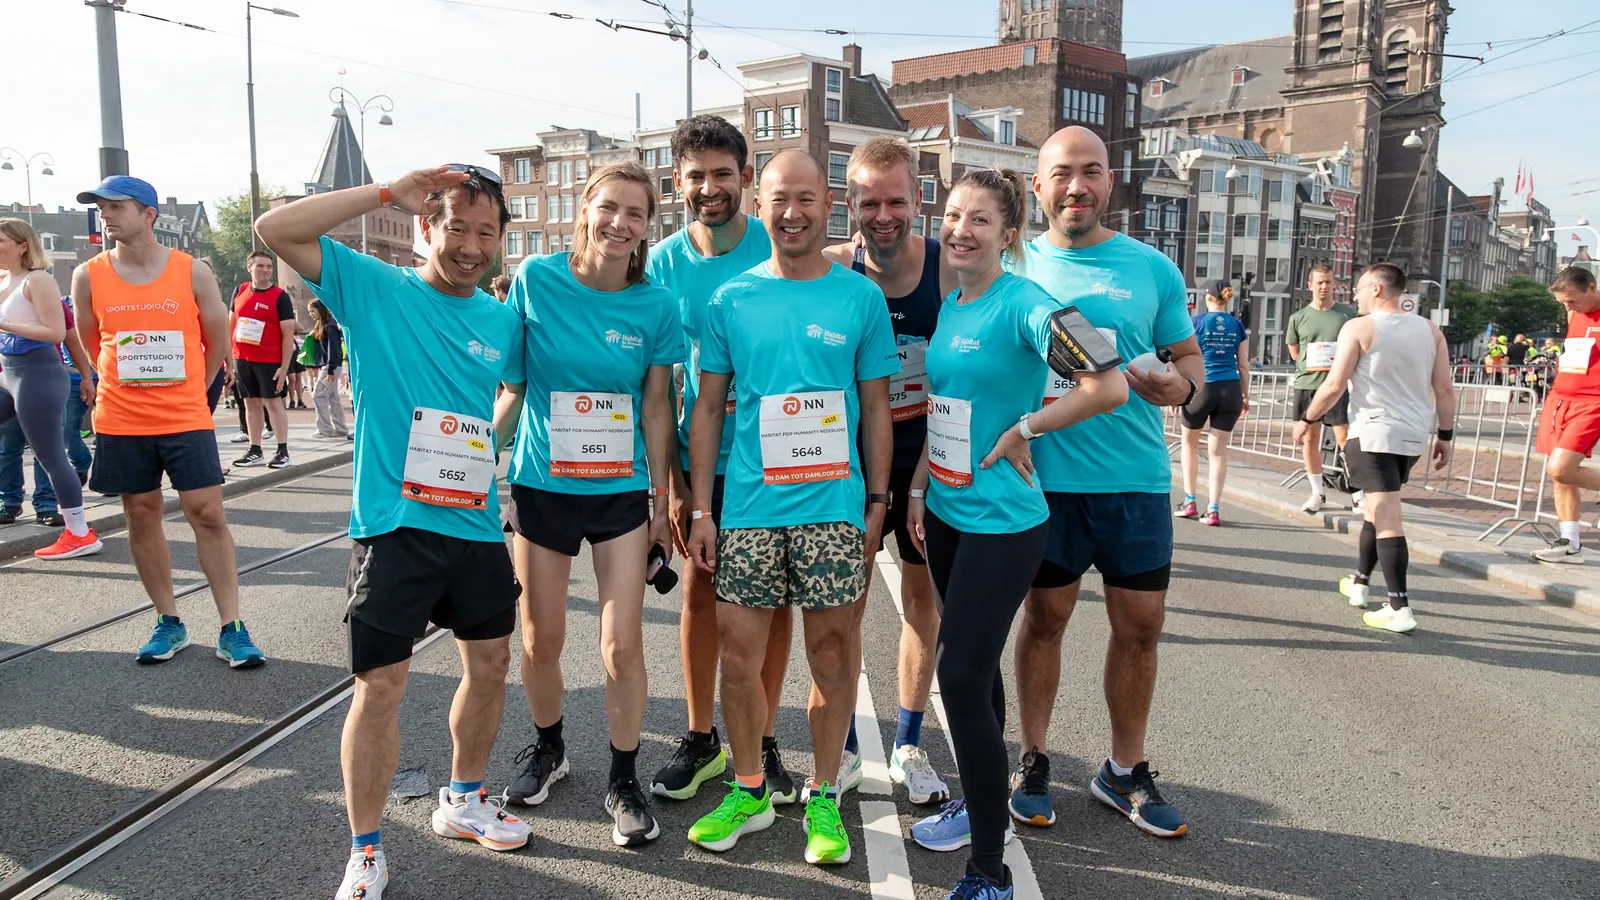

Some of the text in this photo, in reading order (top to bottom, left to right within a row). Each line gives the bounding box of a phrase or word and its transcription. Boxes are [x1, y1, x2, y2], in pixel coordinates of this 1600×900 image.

[105, 303, 161, 313] SPORTSTUDIO
[898, 351, 907, 360] N
[1054, 380, 1076, 388] 565
[889, 391, 907, 402] 675
[596, 400, 612, 409] NN
[804, 399, 824, 409] NN
[935, 403, 950, 415] NN
[461, 422, 479, 435] NN
[582, 445, 606, 453] 5651
[792, 447, 822, 458] 5648
[439, 469, 466, 481] 5652
